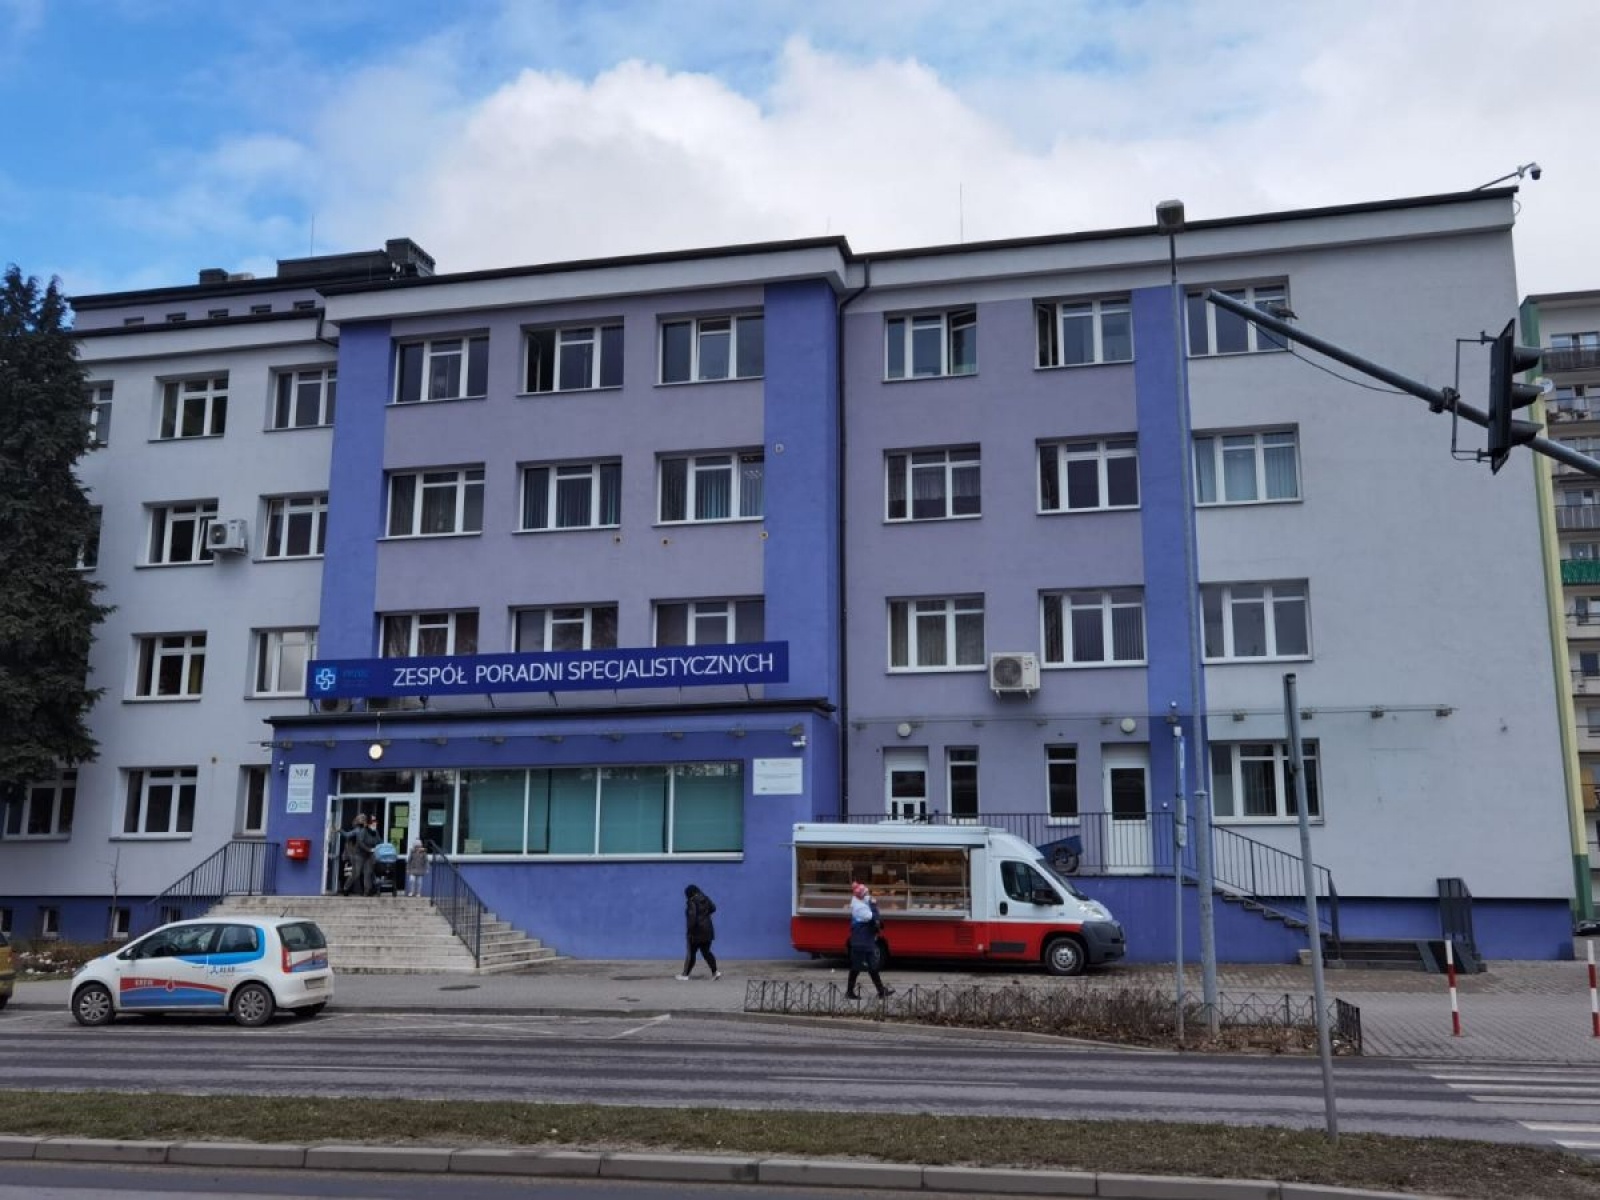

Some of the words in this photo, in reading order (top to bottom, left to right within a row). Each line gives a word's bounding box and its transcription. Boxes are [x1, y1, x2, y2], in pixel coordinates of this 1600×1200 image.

[393, 663, 468, 686] ZESPÓŁ
[475, 662, 563, 684] PORADNI
[567, 652, 774, 682] SPECJALISTYCZNYCH
